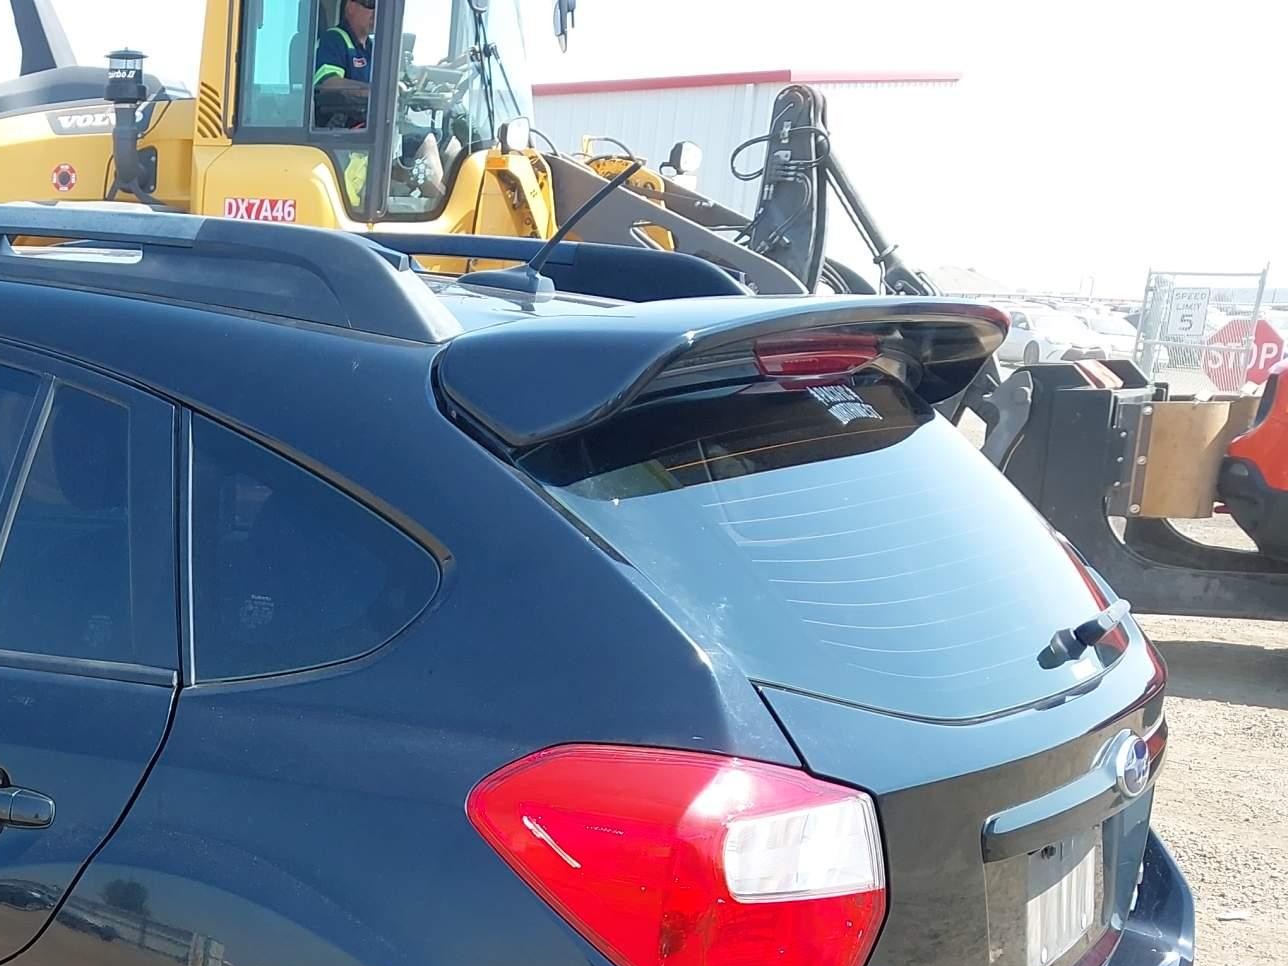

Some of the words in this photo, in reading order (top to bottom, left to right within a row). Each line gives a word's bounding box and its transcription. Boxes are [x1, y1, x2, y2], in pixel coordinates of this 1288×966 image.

[224, 198, 295, 221] DX7A46
[1174, 291, 1208, 301] SPEED
[1176, 303, 1203, 312] LIMIT
[1178, 313, 1194, 331] 5
[1205, 342, 1279, 370] STOP
